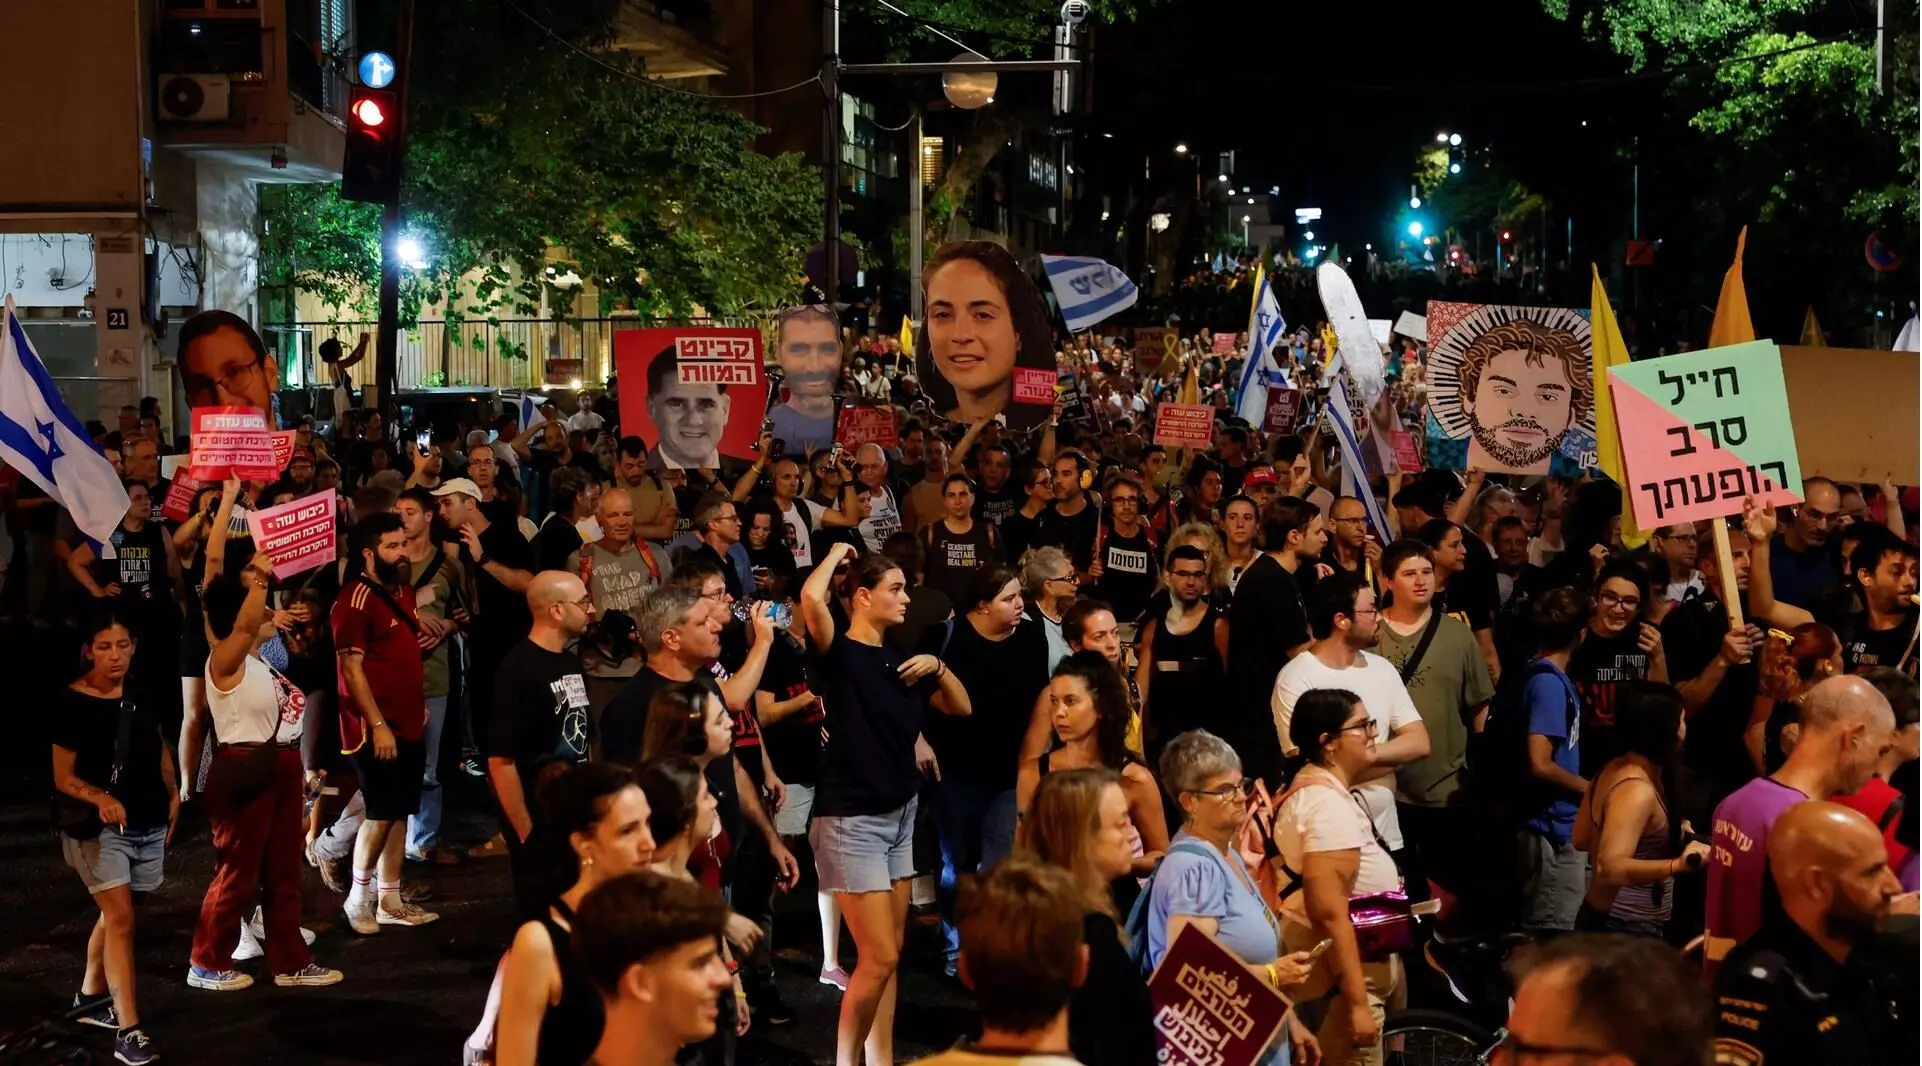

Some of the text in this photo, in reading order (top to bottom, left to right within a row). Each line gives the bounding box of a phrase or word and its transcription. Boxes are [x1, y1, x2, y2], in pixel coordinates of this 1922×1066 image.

[109, 312, 126, 326] 21
[680, 340, 750, 360] קבינט
[681, 365, 753, 383] המוות
[1027, 370, 1055, 384] עדיין
[1658, 366, 1740, 406] חייל
[1666, 415, 1747, 457] סרב
[1640, 460, 1789, 519] הופעתך
[275, 512, 297, 529] עזה
[297, 503, 326, 521] כיבוש
[266, 520, 331, 550] הקרבת החטופים
[270, 537, 329, 563] והקרבת החיילי
[947, 543, 976, 551] CEASEFIRE
[947, 550, 976, 559] HOSTAGE
[947, 558, 961, 567] DEAL
